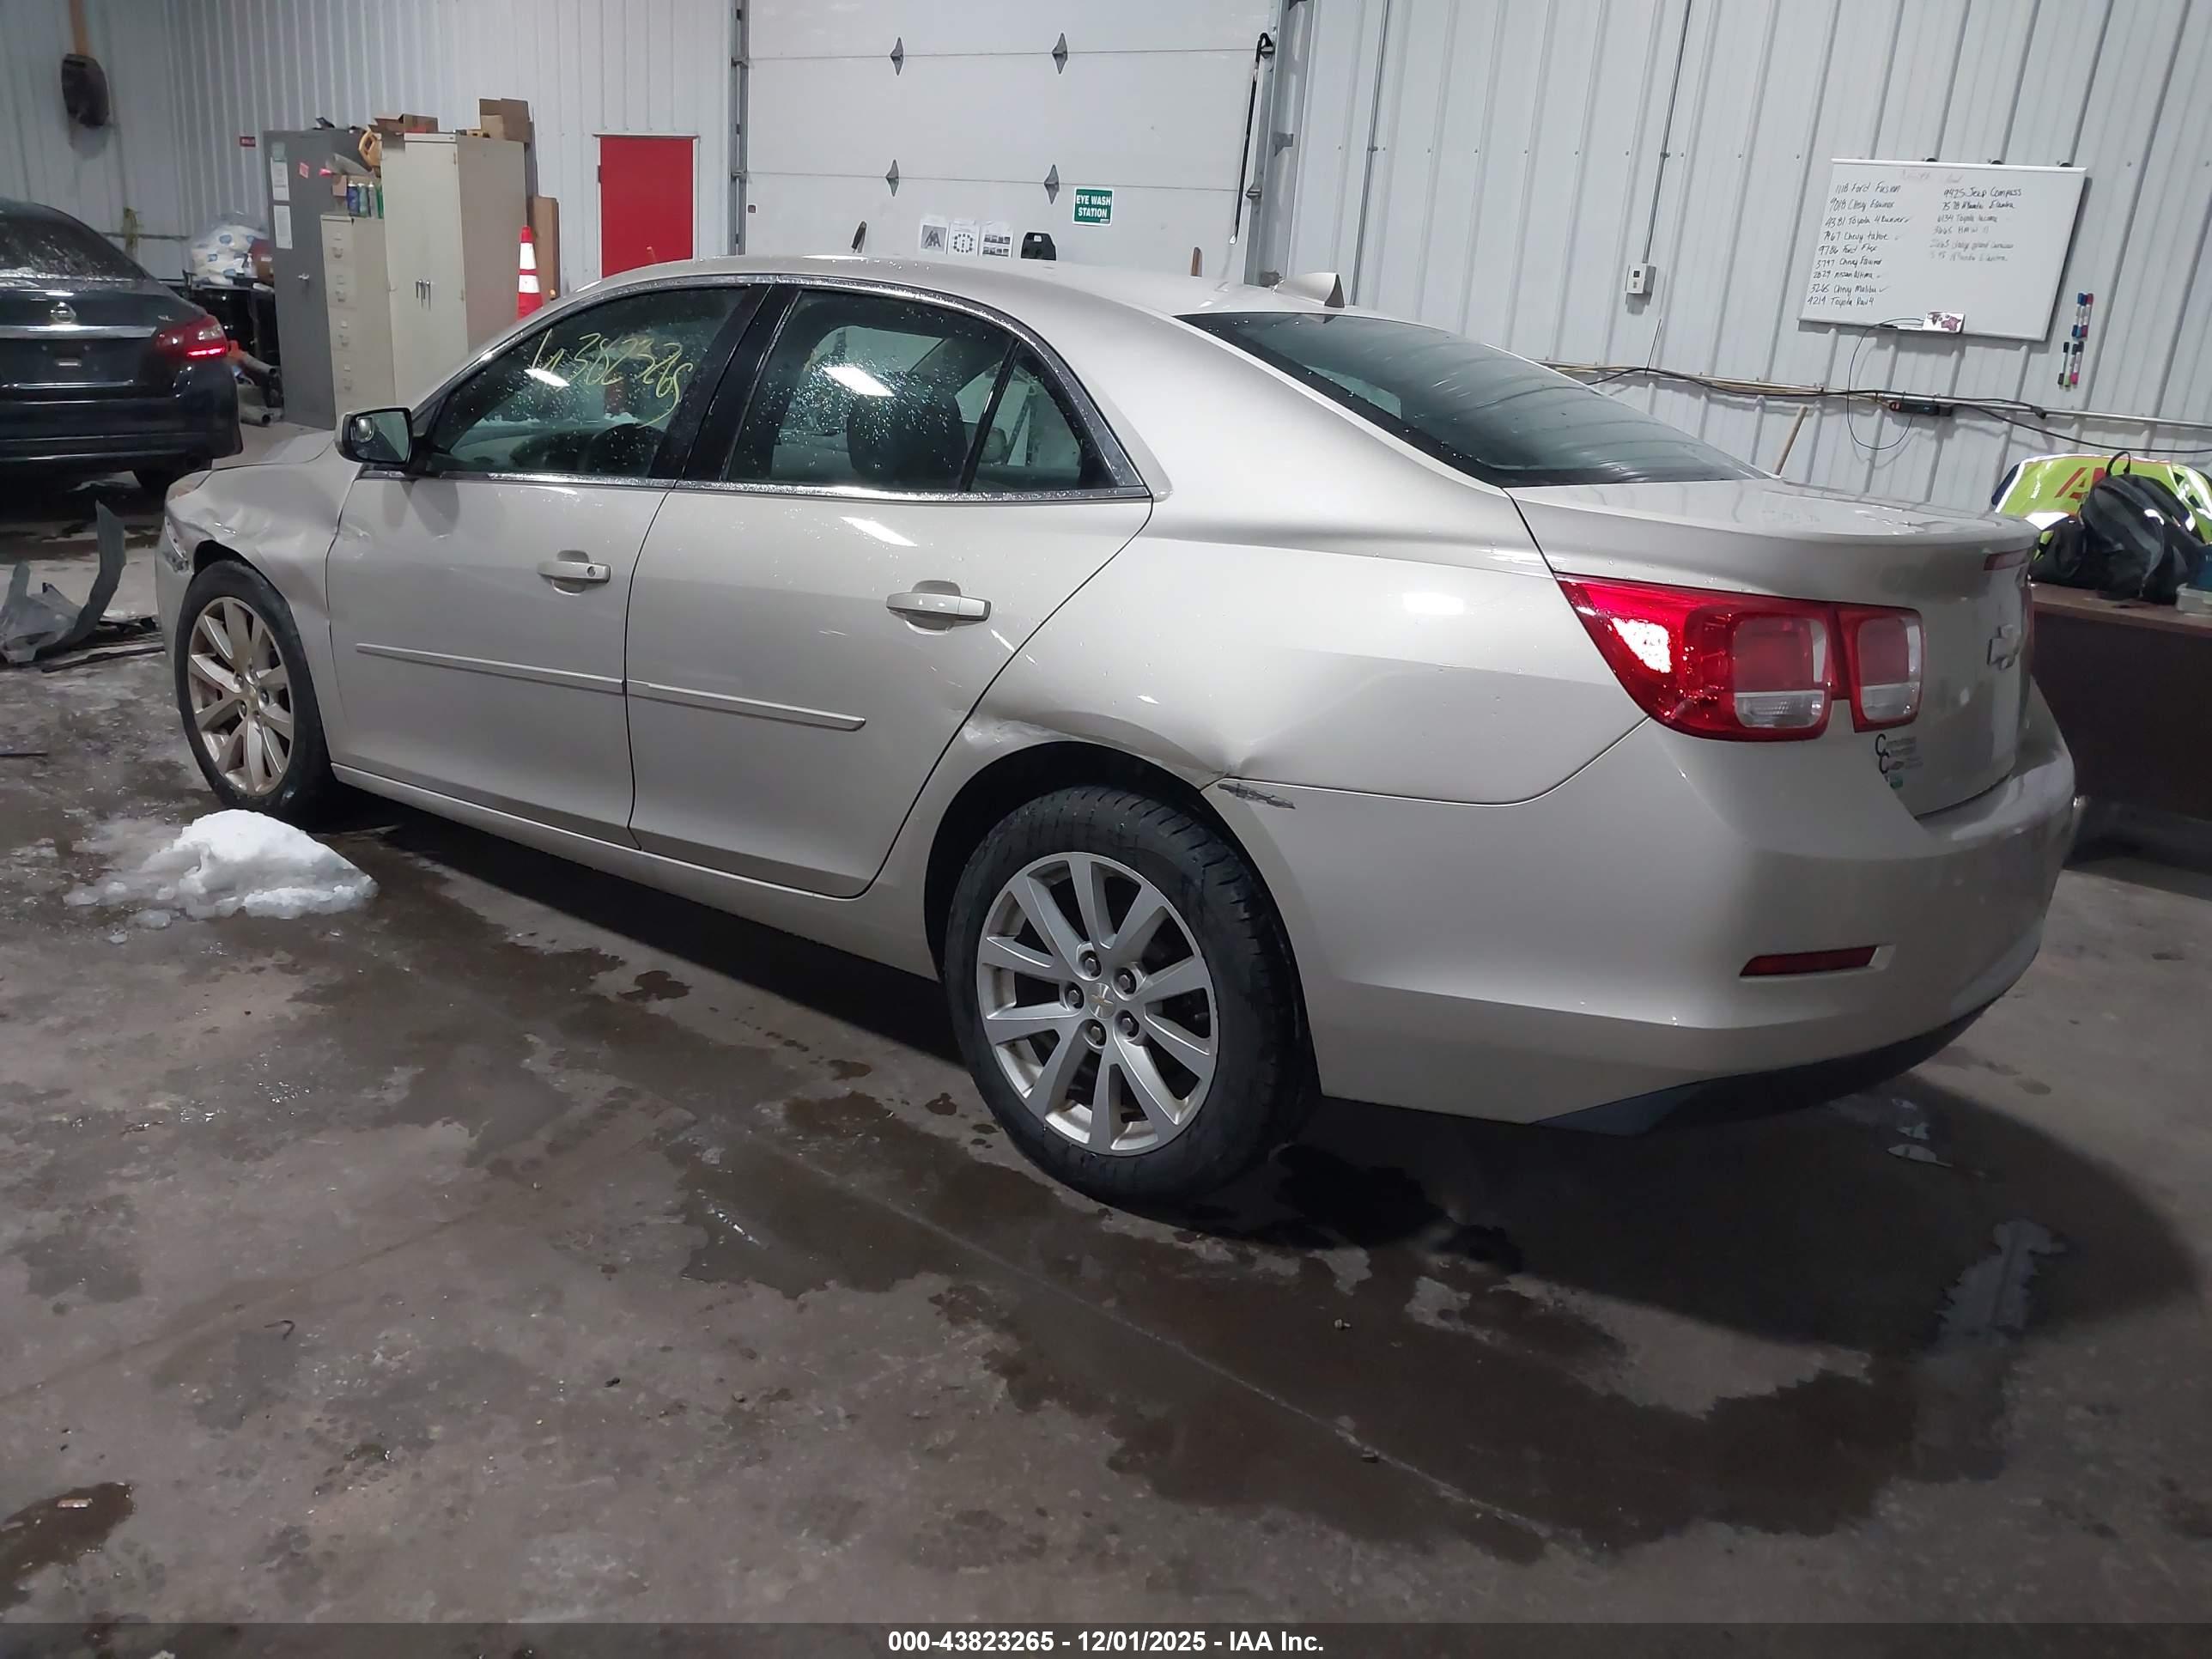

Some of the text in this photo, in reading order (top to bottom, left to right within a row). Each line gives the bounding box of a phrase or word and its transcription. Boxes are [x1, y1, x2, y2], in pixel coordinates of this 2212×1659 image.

[1851, 182, 1871, 192] Ford
[1076, 194, 1111, 206] EYE WASH
[1078, 207, 1108, 218] STATION
[1844, 232, 1863, 243] Chevy
